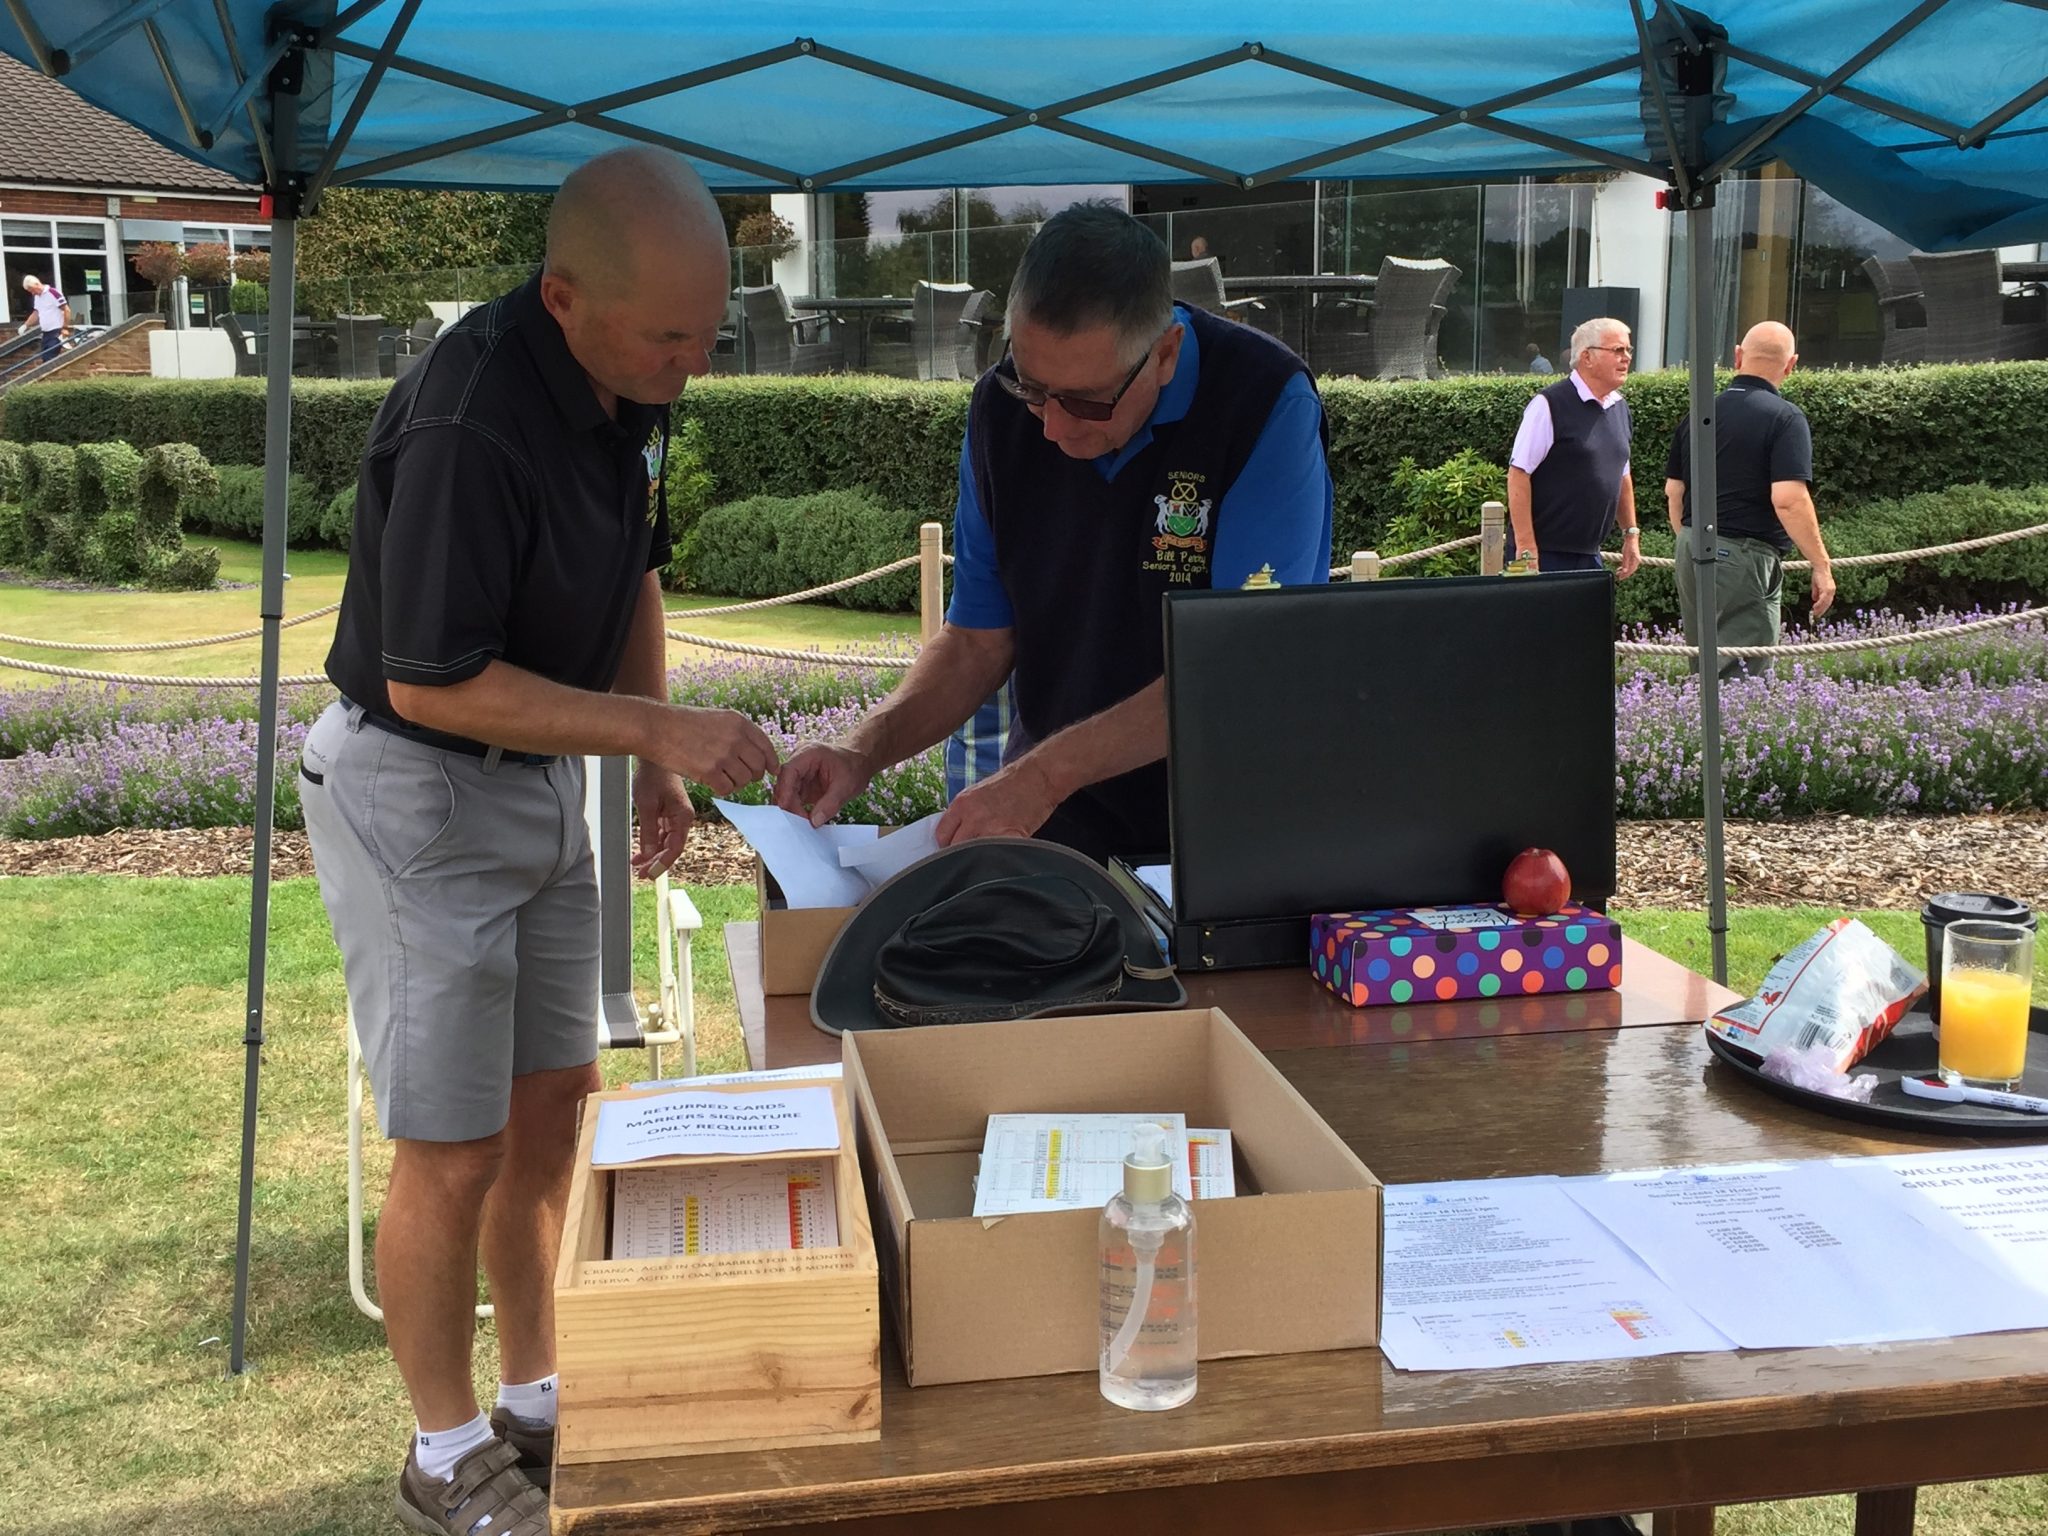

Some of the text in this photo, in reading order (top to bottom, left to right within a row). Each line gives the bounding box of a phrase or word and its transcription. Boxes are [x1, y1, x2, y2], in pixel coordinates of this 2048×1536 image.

[1167, 471, 1206, 483] SENIORS
[1156, 550, 1175, 562] Bill
[1142, 561, 1177, 571] Seniors
[1169, 572, 1192, 584] 2014
[643, 1102, 786, 1116] RETURNED CARDS
[626, 1112, 801, 1128] MARKERS SIGNATURE
[647, 1123, 780, 1135] ONLY REQUIRED
[1893, 1163, 2005, 1177] WELCOLME
[2003, 1161, 2034, 1169] TO
[1901, 1178, 1965, 1189] GREAT
[1968, 1174, 2024, 1185] BARR
[641, 1264, 672, 1273] AGED
[691, 1261, 715, 1269] OAK
[718, 1259, 763, 1267] BARRELS
[805, 1252, 854, 1261] MONTHS
[637, 1275, 669, 1283] AGED
[715, 1269, 761, 1277] BARRELS
[763, 1266, 785, 1274] FOR
[805, 1263, 855, 1271] MONTHS
[540, 1381, 552, 1393] FJ
[420, 1436, 430, 1446] FJ
